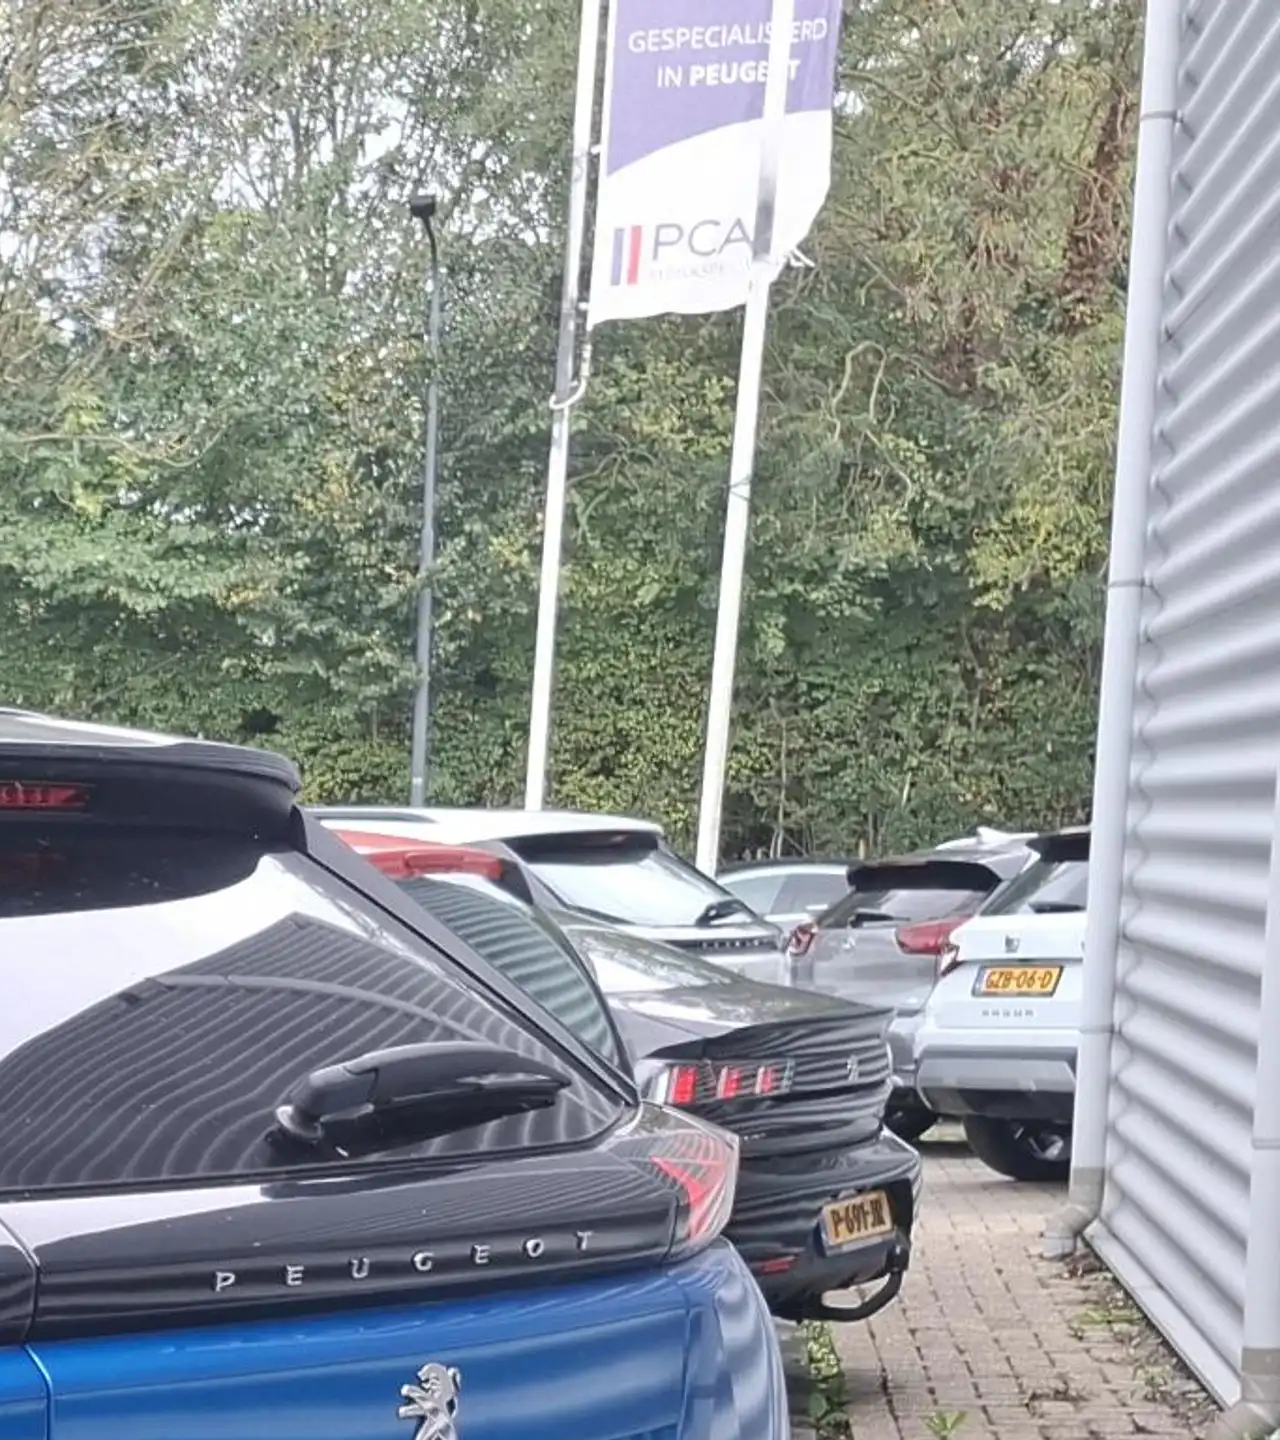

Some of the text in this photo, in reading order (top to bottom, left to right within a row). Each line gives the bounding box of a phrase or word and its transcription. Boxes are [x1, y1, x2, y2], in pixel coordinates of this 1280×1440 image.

[628, 17, 828, 53] GESPECIALISERD
[656, 59, 801, 88] IN PEUGET
[651, 217, 755, 261] PCA
[214, 1229, 595, 1293] PEUGEOT
